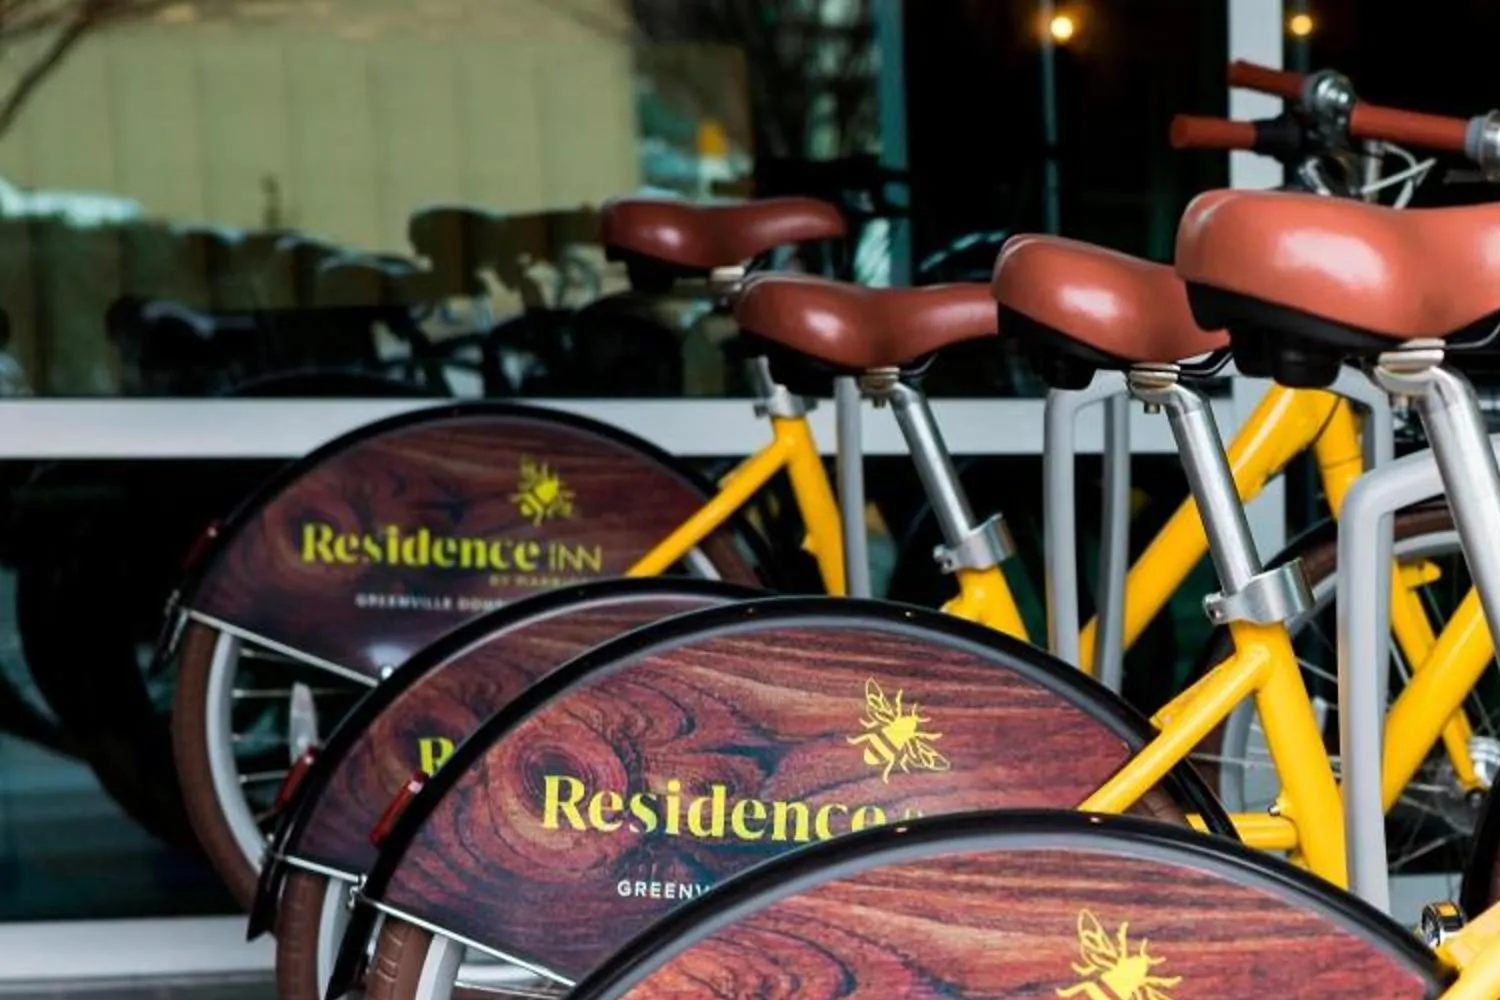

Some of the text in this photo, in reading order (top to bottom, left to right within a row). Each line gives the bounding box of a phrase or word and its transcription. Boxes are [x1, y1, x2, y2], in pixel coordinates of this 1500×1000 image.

[303, 523, 602, 573] Residence INN
[543, 774, 887, 840] Residence
[617, 880, 711, 900] GREENV
